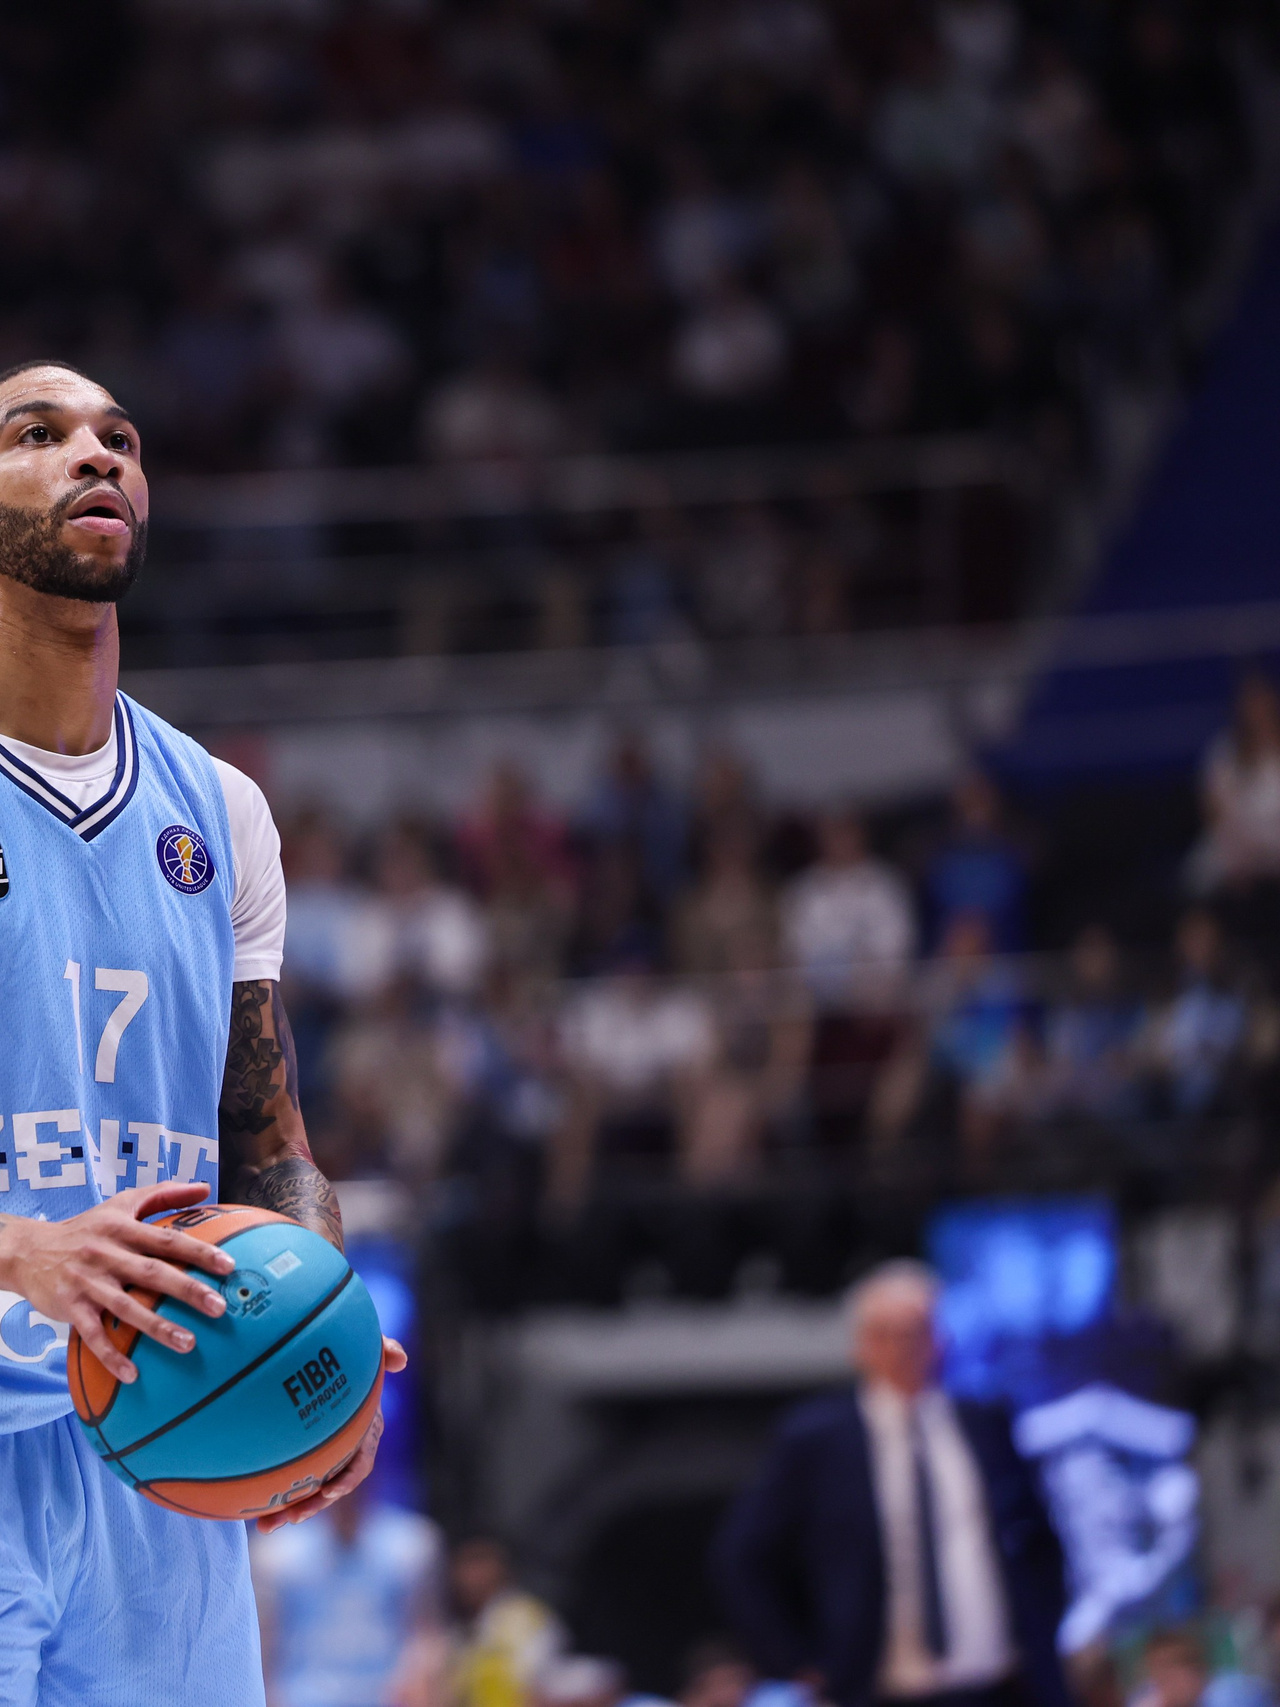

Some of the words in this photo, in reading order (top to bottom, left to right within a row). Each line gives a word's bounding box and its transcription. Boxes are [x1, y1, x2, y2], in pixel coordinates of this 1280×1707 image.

[63, 959, 149, 1083] 17
[283, 1346, 341, 1407] FIBA
[298, 1373, 348, 1420] APPROVED
